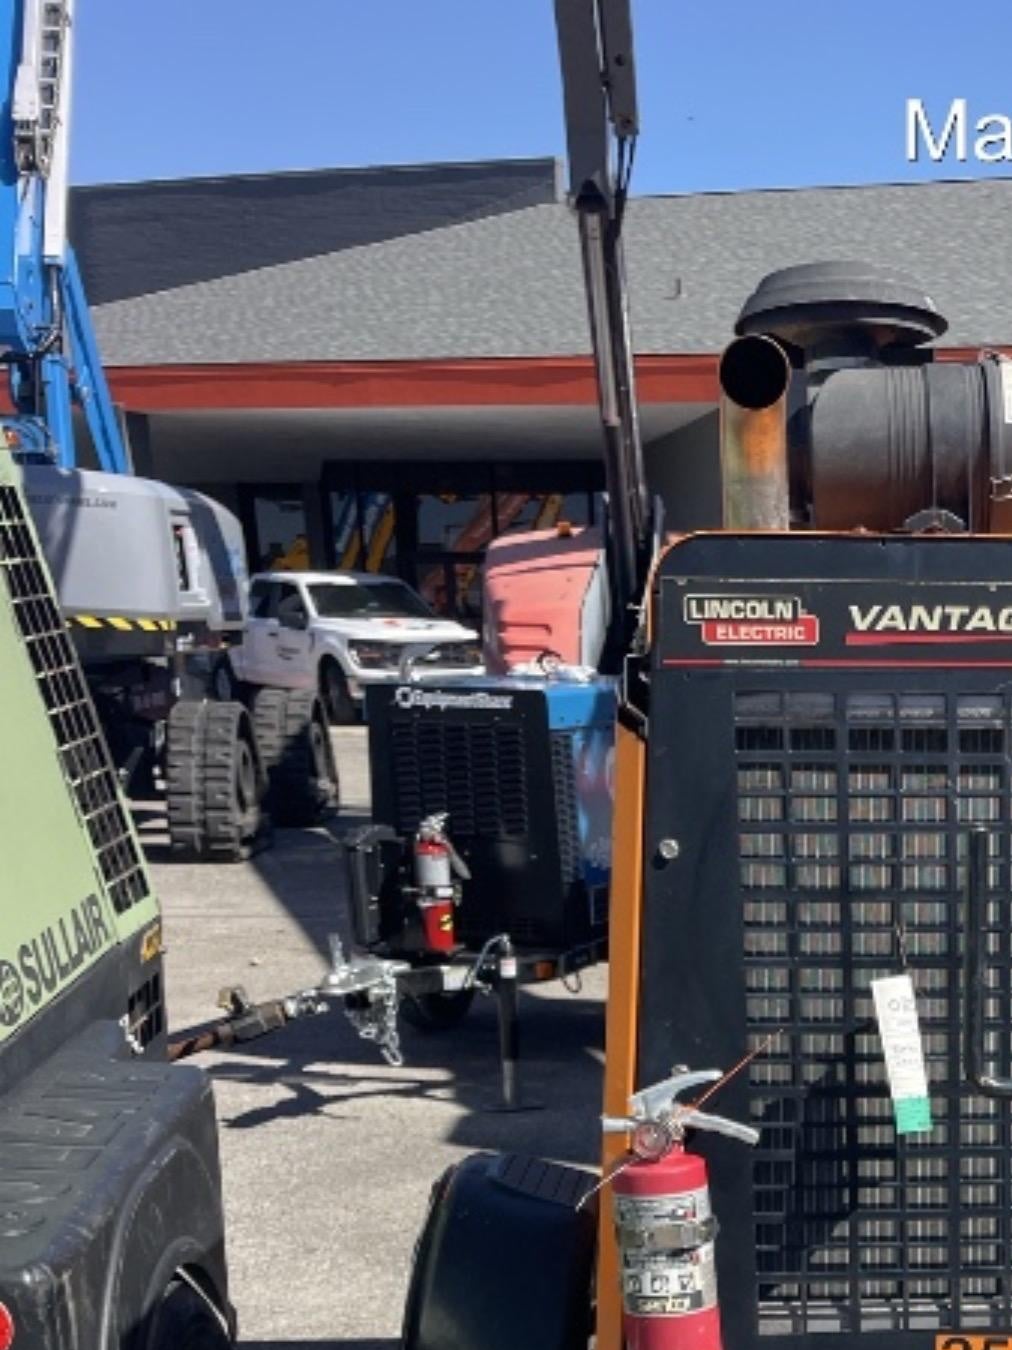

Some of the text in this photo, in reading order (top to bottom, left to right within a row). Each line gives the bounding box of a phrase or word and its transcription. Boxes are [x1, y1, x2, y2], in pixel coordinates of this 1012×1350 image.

[689, 600, 793, 620] LINCOLN
[715, 624, 806, 641] ELECTRIC
[18, 892, 110, 1005] SULLAIR
